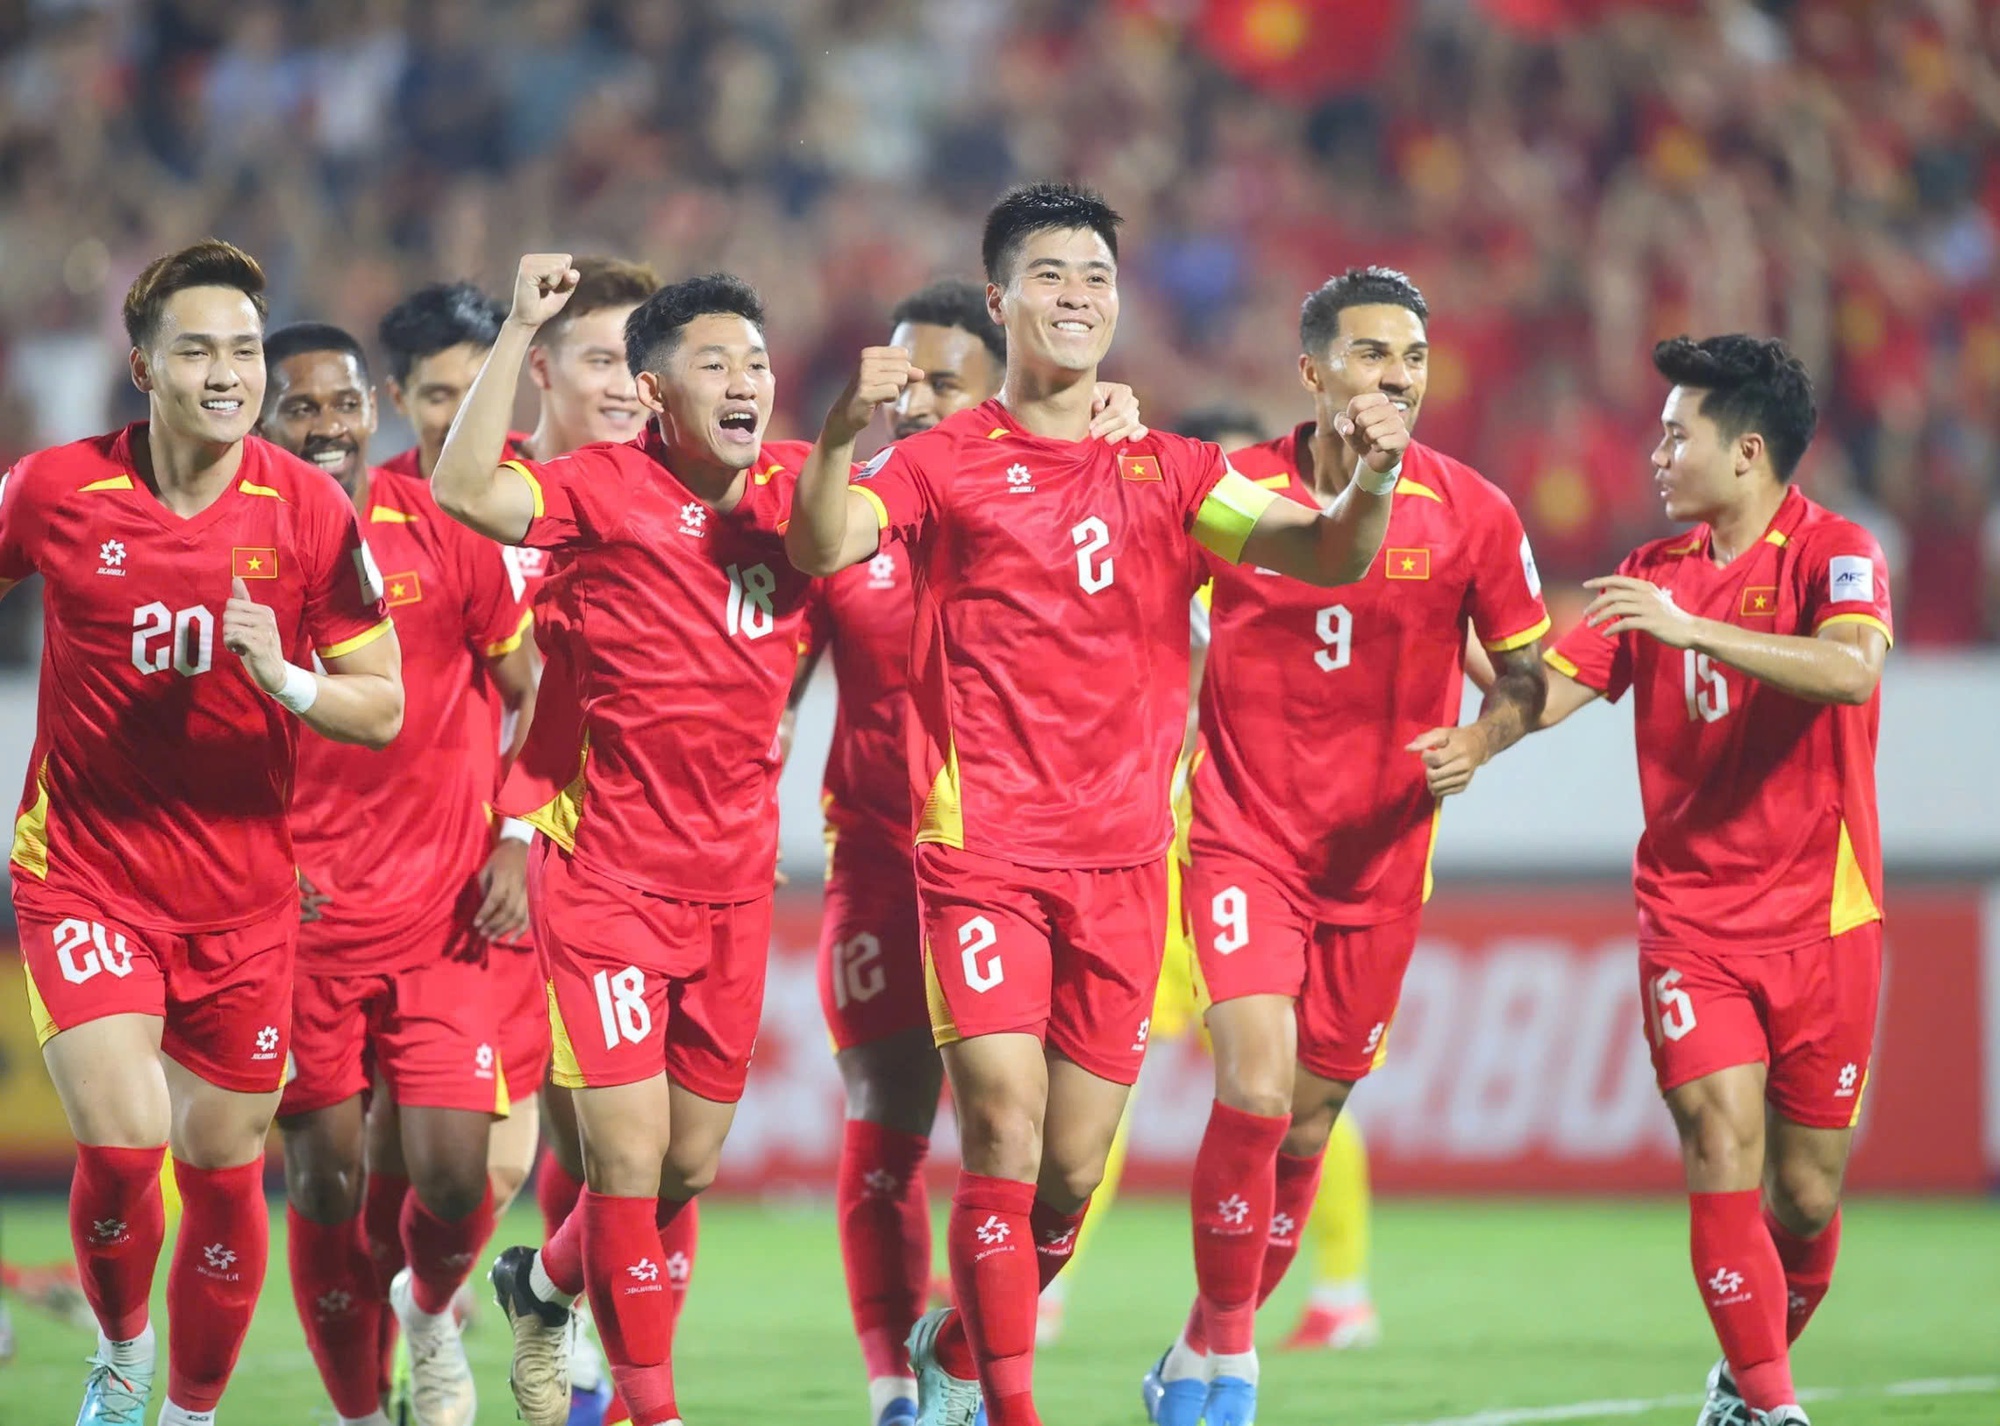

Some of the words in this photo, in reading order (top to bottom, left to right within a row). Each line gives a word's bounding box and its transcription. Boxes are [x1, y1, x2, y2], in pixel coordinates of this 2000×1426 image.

[1072, 516, 1113, 595] 2
[132, 601, 214, 677] 20
[726, 563, 777, 640] 18
[1314, 604, 1353, 672] 9
[1684, 648, 1729, 723] 15
[52, 918, 133, 985] 20
[958, 915, 1004, 994] 2
[1212, 885, 1249, 955] 9
[593, 965, 652, 1049] 18
[833, 931, 887, 1009] 12
[1649, 967, 1697, 1049] 15
